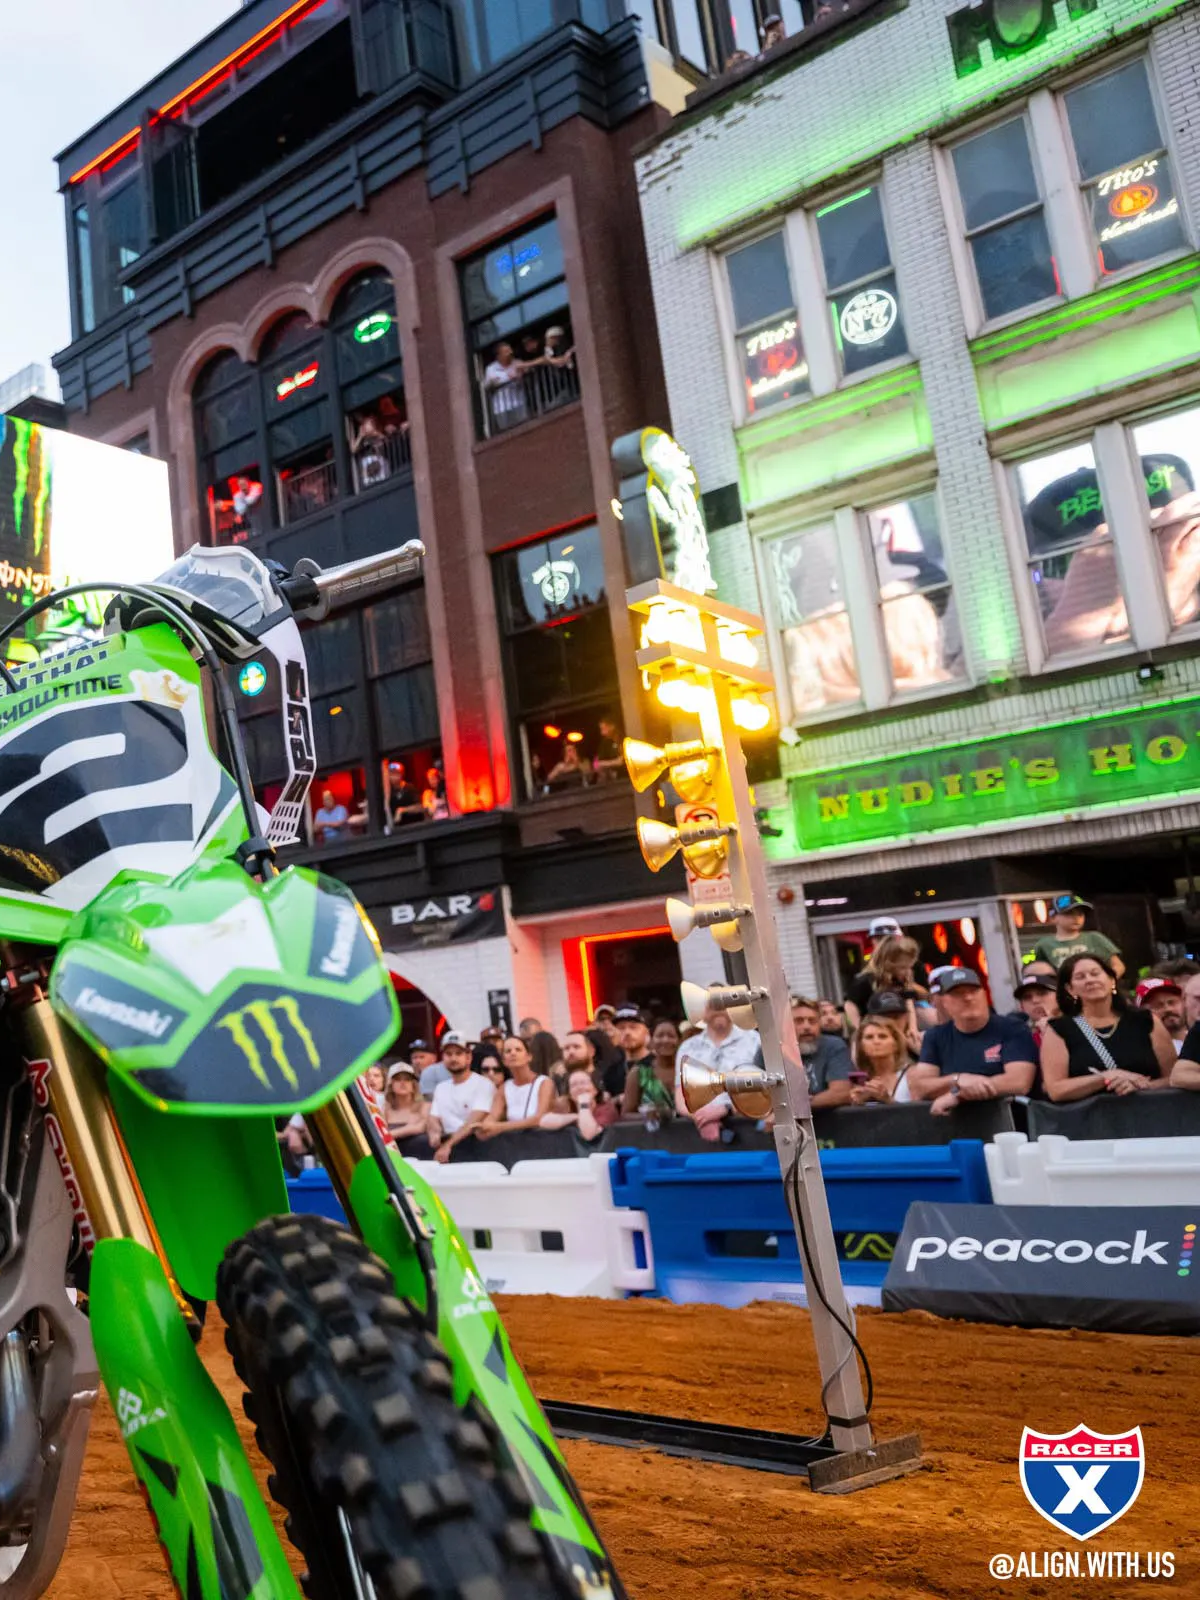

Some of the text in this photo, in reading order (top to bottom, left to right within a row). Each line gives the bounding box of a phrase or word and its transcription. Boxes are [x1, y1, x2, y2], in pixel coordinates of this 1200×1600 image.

[819, 734, 1200, 822] NUDIE'S HO
[391, 895, 473, 925] BAR
[75, 987, 173, 1038] Kawasaki
[906, 1229, 1169, 1272] peacock
